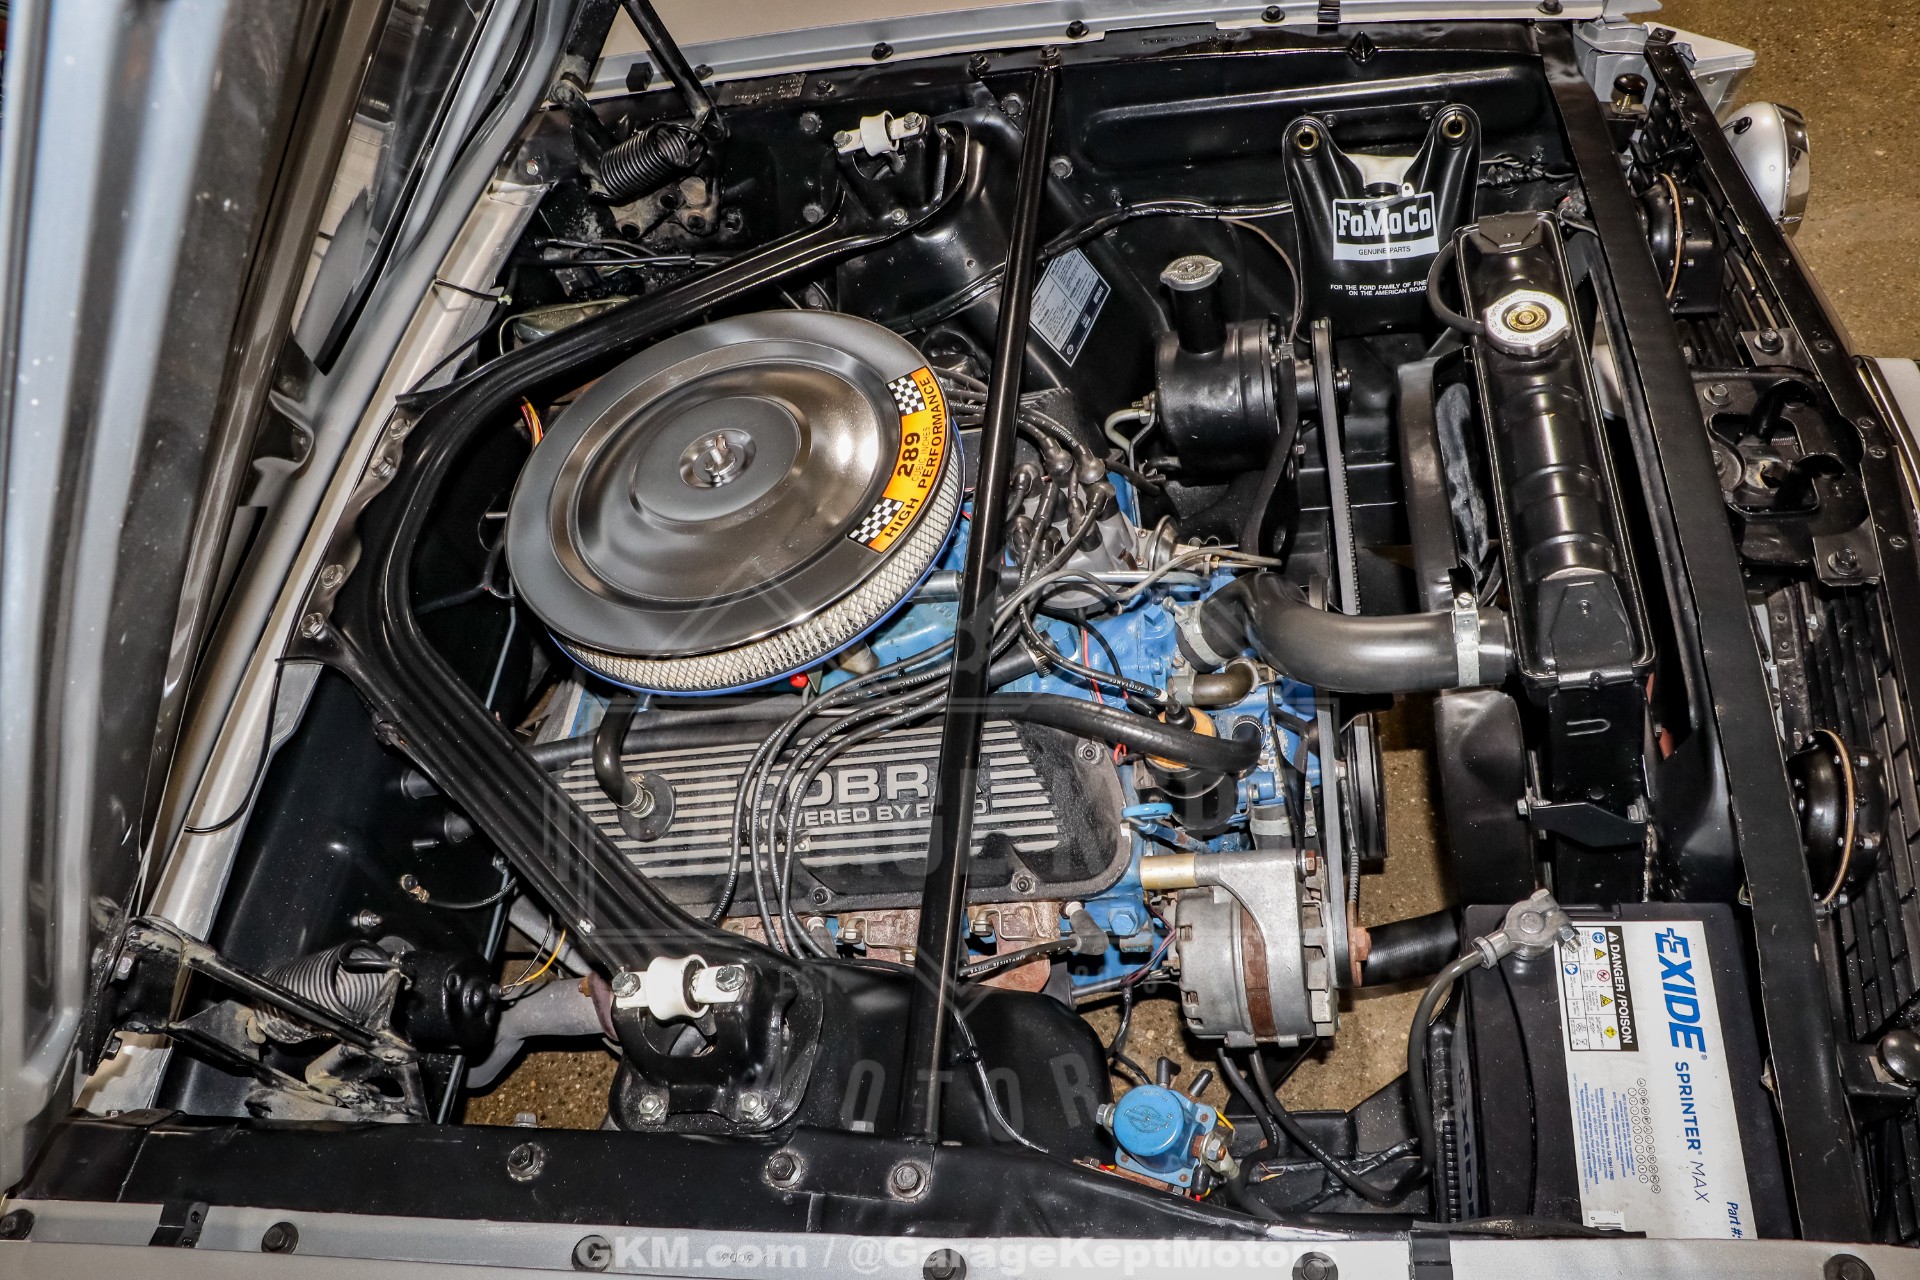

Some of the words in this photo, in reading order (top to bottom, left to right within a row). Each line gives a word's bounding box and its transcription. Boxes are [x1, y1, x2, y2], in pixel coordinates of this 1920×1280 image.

[1337, 204, 1432, 237] FoMoCo
[1358, 247, 1387, 256] GENUINE
[1389, 245, 1411, 254] PARTS
[1374, 287, 1407, 296] AMERICAN
[1378, 282, 1401, 291] FAMILY
[885, 497, 920, 539] HIGH
[917, 376, 944, 490] PERFORMANCE
[896, 431, 921, 478] 289
[745, 763, 983, 810] COBR
[745, 803, 870, 832] WERED
[876, 804, 911, 821] BY
[916, 799, 987, 818] FD
[1610, 944, 1626, 995] DANGER
[1618, 998, 1633, 1044] POISON
[1675, 1060, 1702, 1151] SPRINTER
[1690, 1160, 1710, 1204] MAX
[1726, 1201, 1741, 1226] Part
